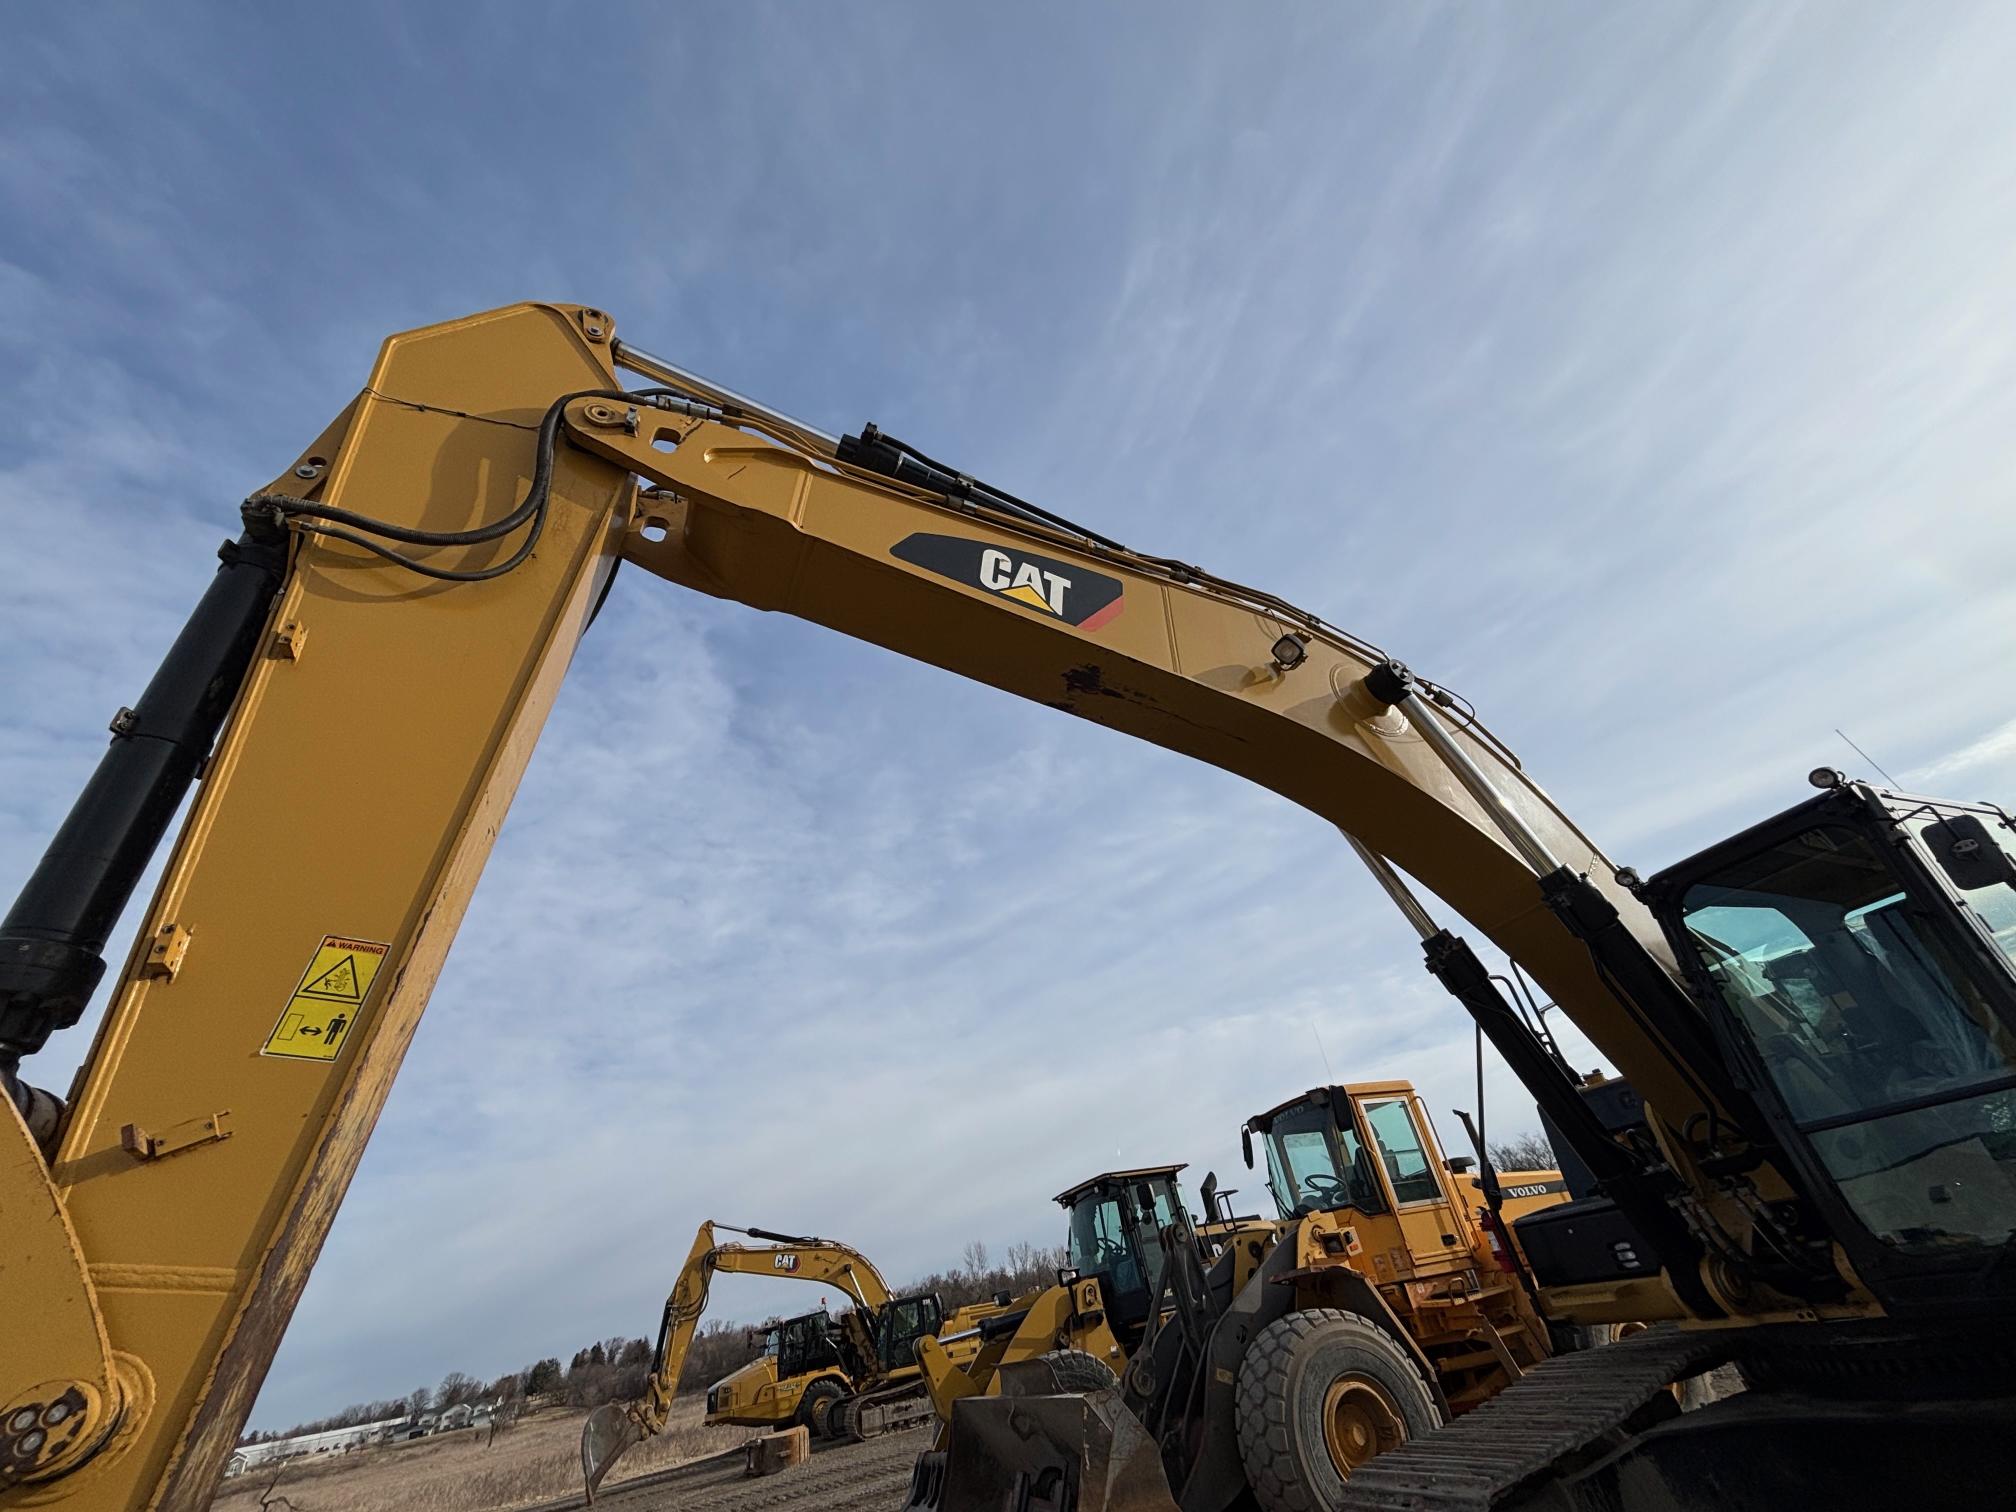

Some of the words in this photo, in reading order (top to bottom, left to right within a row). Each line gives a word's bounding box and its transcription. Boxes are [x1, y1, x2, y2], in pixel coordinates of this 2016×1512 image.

[980, 549, 1071, 616] CAT
[338, 942, 383, 955] WARNING
[1508, 1185, 1547, 1198] VOLVO
[774, 1254, 796, 1269] CAT
